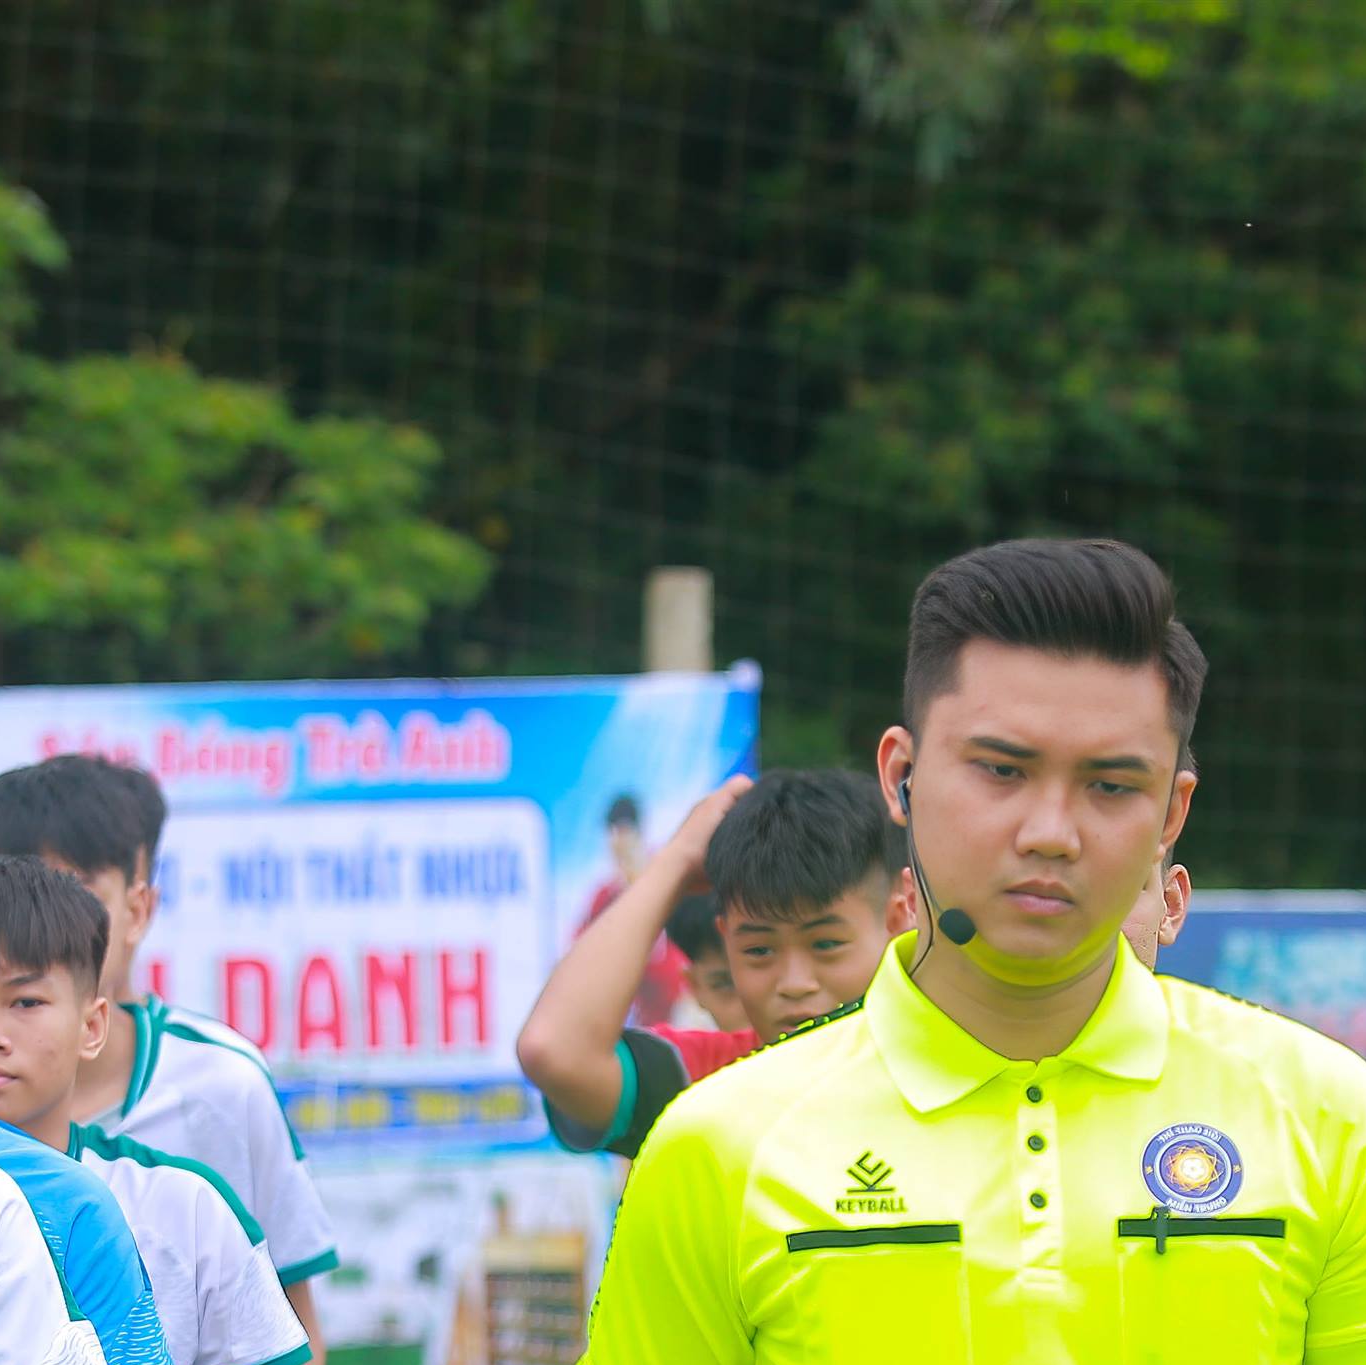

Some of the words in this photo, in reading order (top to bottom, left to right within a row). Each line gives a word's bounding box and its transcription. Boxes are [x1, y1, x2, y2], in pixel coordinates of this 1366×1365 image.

[397, 717, 503, 775] Anh
[223, 944, 491, 1056] DANH
[835, 1197, 907, 1213] KEYBALL
